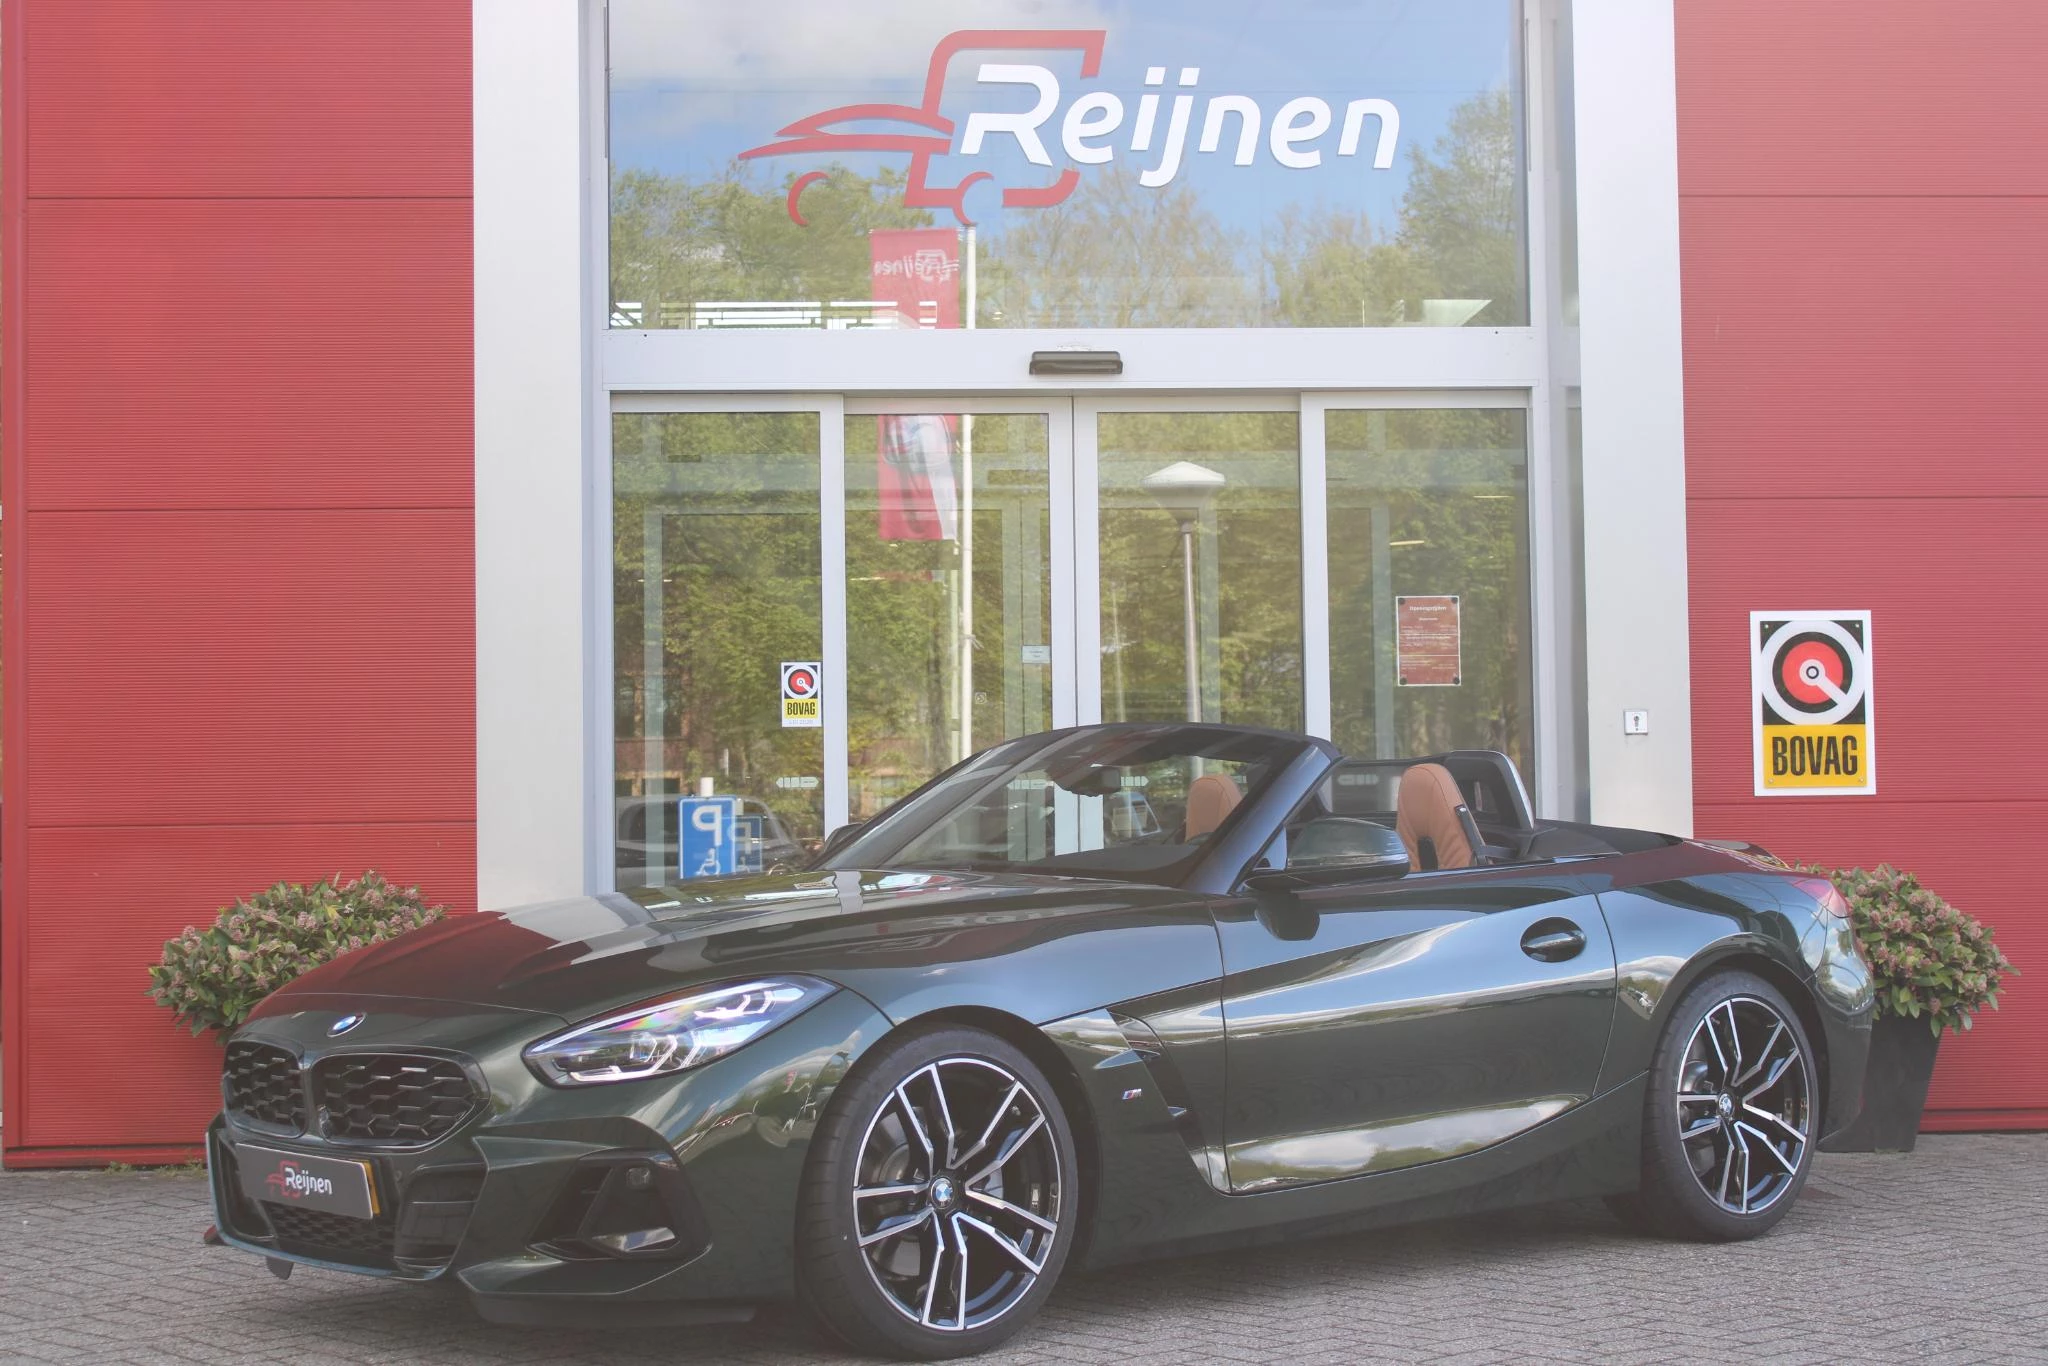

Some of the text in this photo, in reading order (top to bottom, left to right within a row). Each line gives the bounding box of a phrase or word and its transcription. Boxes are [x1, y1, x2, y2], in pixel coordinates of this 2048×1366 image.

[960, 64, 1400, 188] Reijnen
[787, 702, 816, 715] BOVAG
[1772, 735, 1858, 776] BOVAG
[285, 1167, 333, 1196] Reijnen
